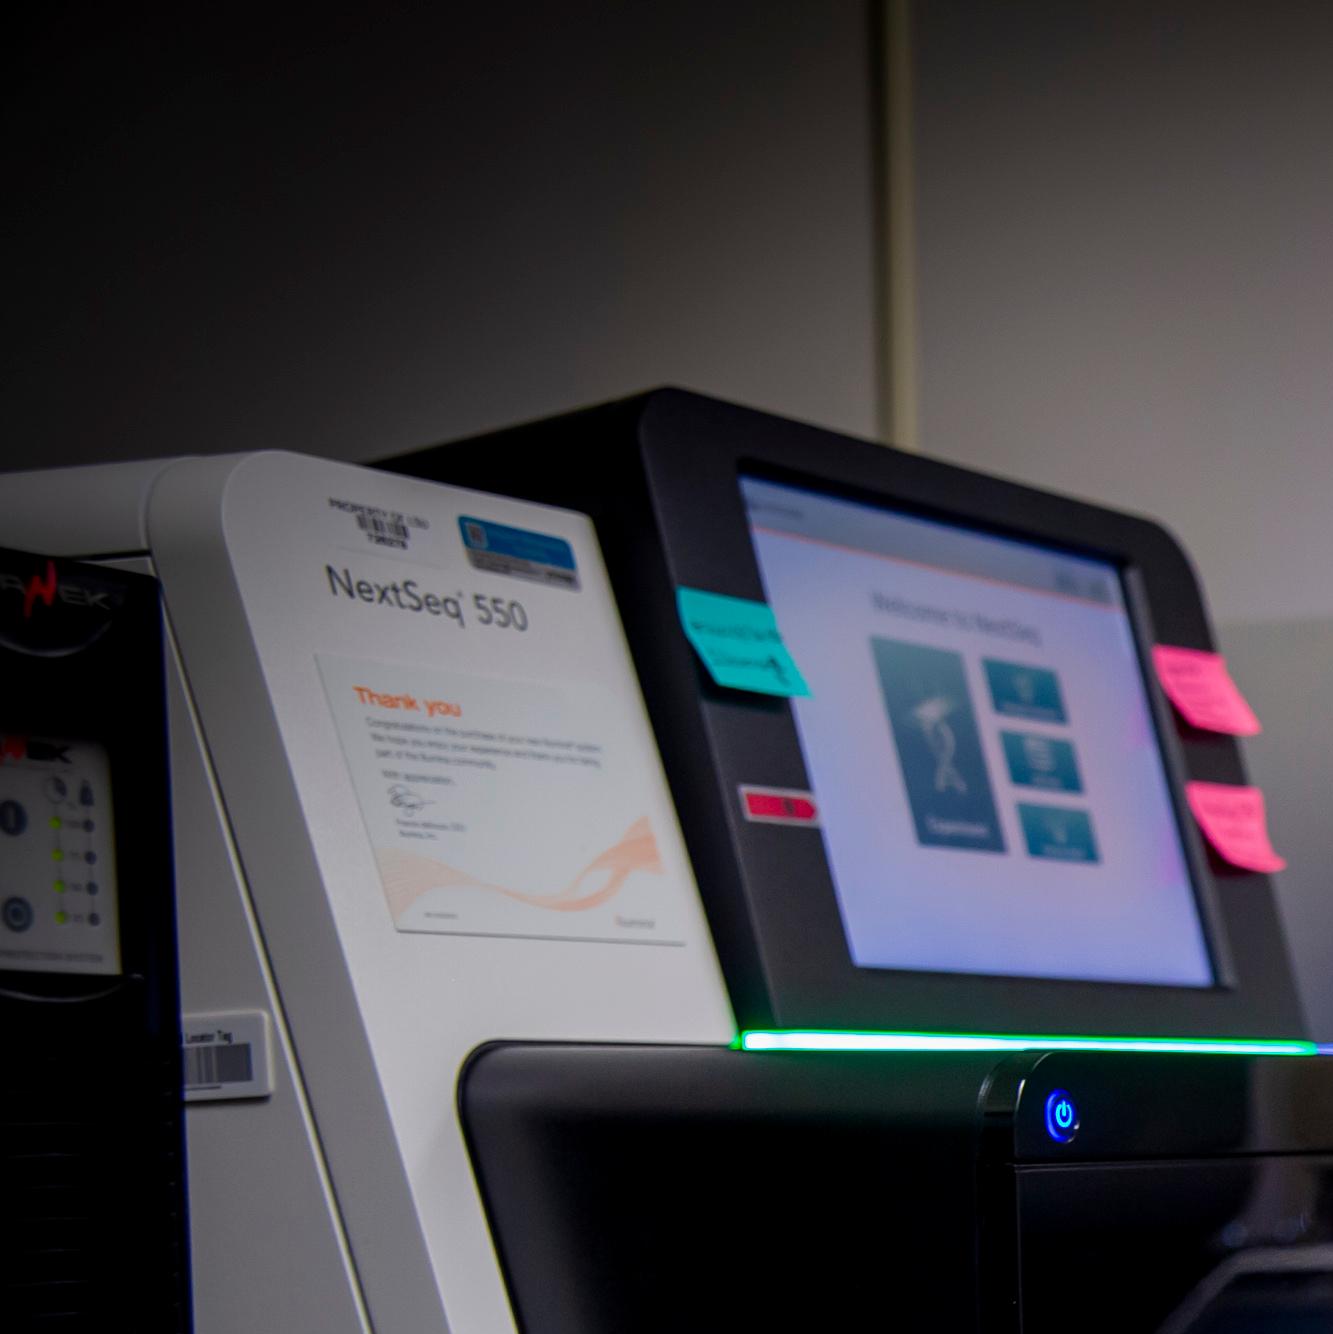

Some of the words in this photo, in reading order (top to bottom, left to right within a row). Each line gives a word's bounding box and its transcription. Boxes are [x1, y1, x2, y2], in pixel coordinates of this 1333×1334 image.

[473, 593, 530, 633] 550
[353, 684, 419, 711] Thank
[424, 699, 463, 719] you
